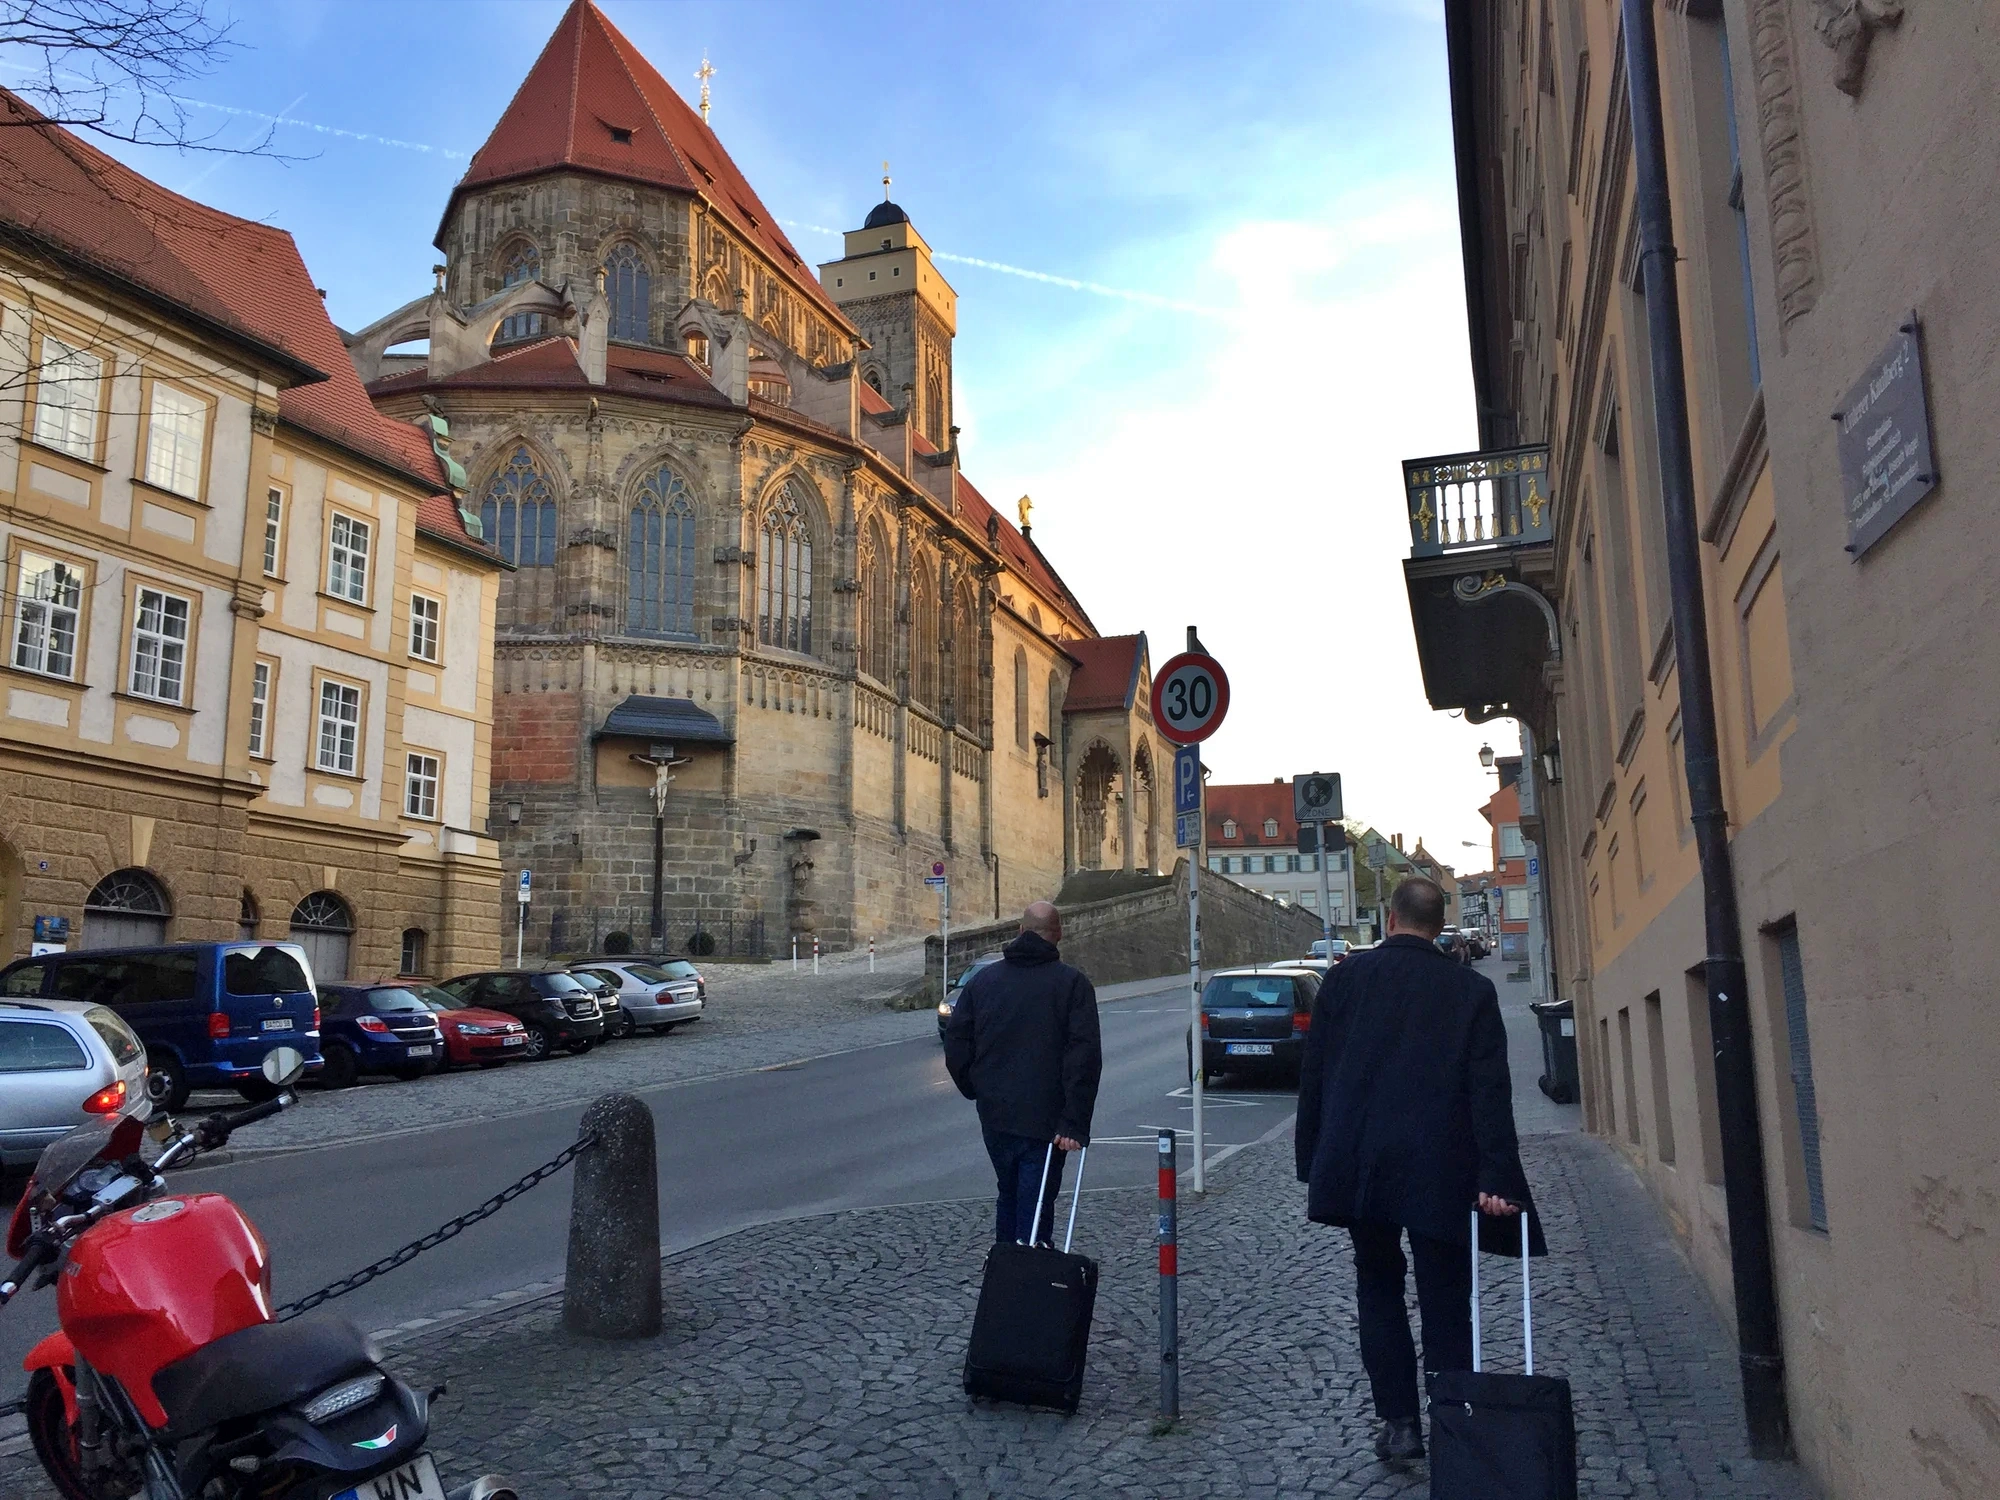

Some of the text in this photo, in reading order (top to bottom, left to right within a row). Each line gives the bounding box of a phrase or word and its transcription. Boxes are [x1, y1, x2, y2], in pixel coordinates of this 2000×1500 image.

[1167, 675, 1212, 721] 30
[1180, 755, 1194, 804] P
[1306, 808, 1331, 818] ZONE
[373, 1463, 423, 1500] WN
